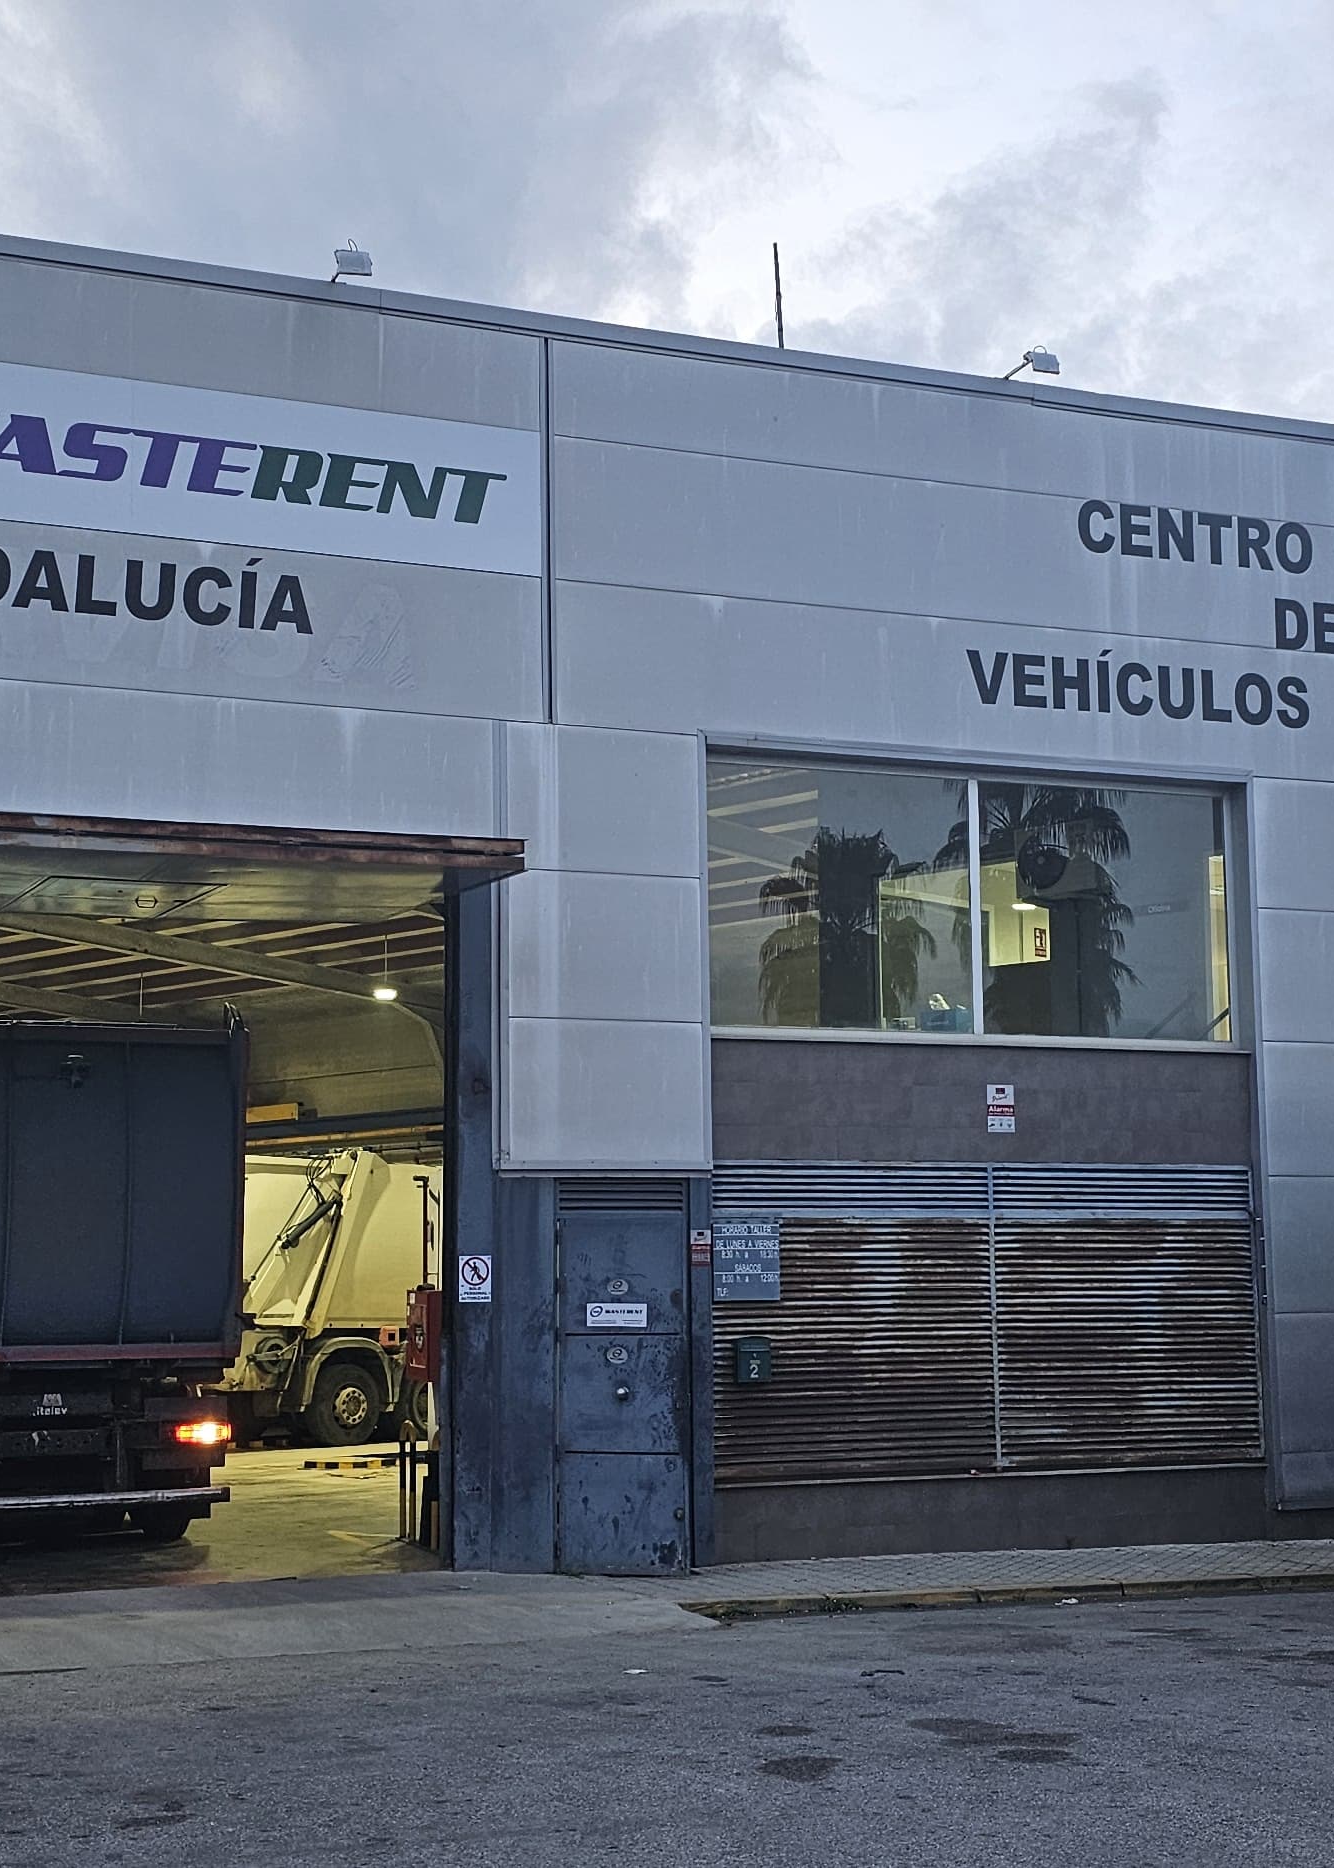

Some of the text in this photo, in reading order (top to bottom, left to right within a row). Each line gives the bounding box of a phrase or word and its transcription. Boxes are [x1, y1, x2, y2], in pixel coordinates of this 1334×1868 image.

[1077, 499, 1313, 575] CENTRO
[966, 649, 1310, 730] VEHÍCULOS
[750, 1364, 759, 1378] 2
